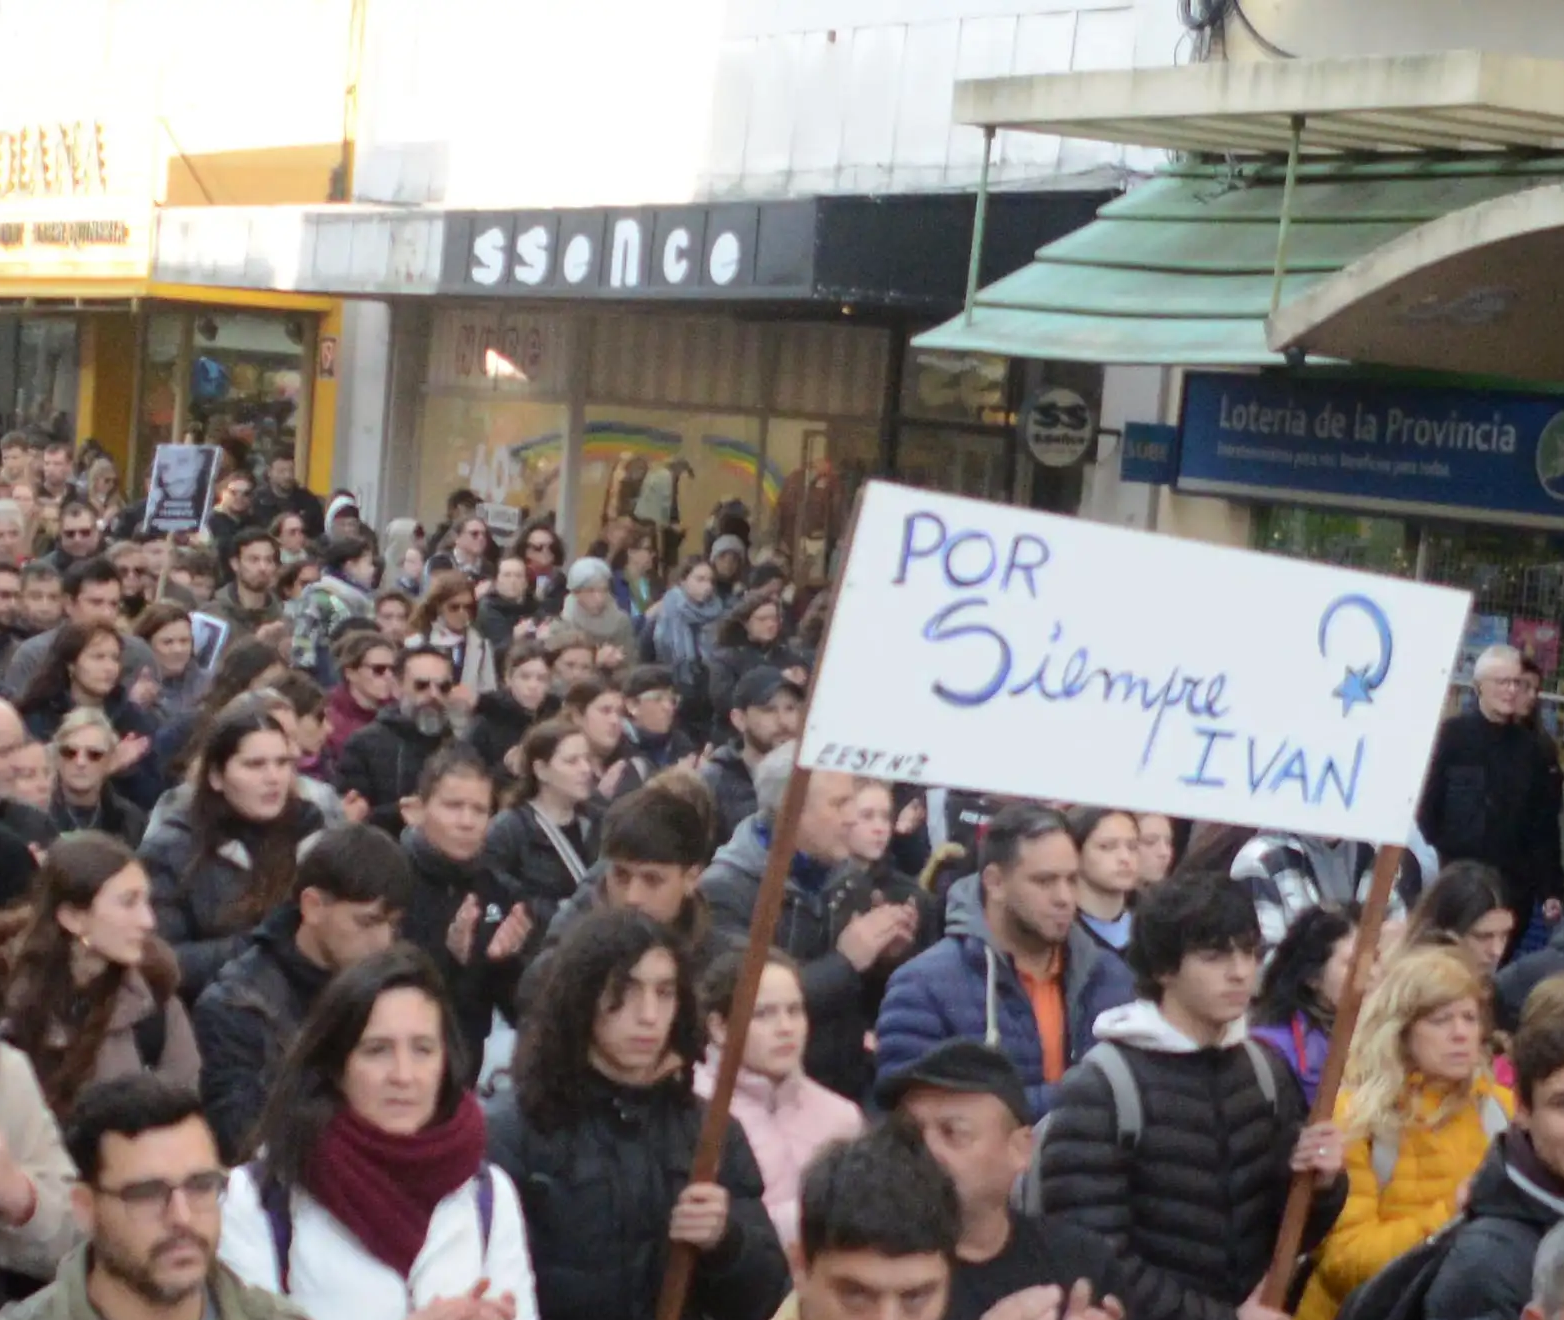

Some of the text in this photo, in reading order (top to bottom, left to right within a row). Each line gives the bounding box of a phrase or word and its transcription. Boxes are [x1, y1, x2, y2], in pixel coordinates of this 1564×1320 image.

[1314, 402, 1345, 440] de
[1353, 402, 1378, 443] la
[1386, 407, 1518, 453] Provincia
[891, 511, 1051, 598] POR
[922, 596, 1231, 772] Siempre
[1178, 725, 1366, 812] IVAN
